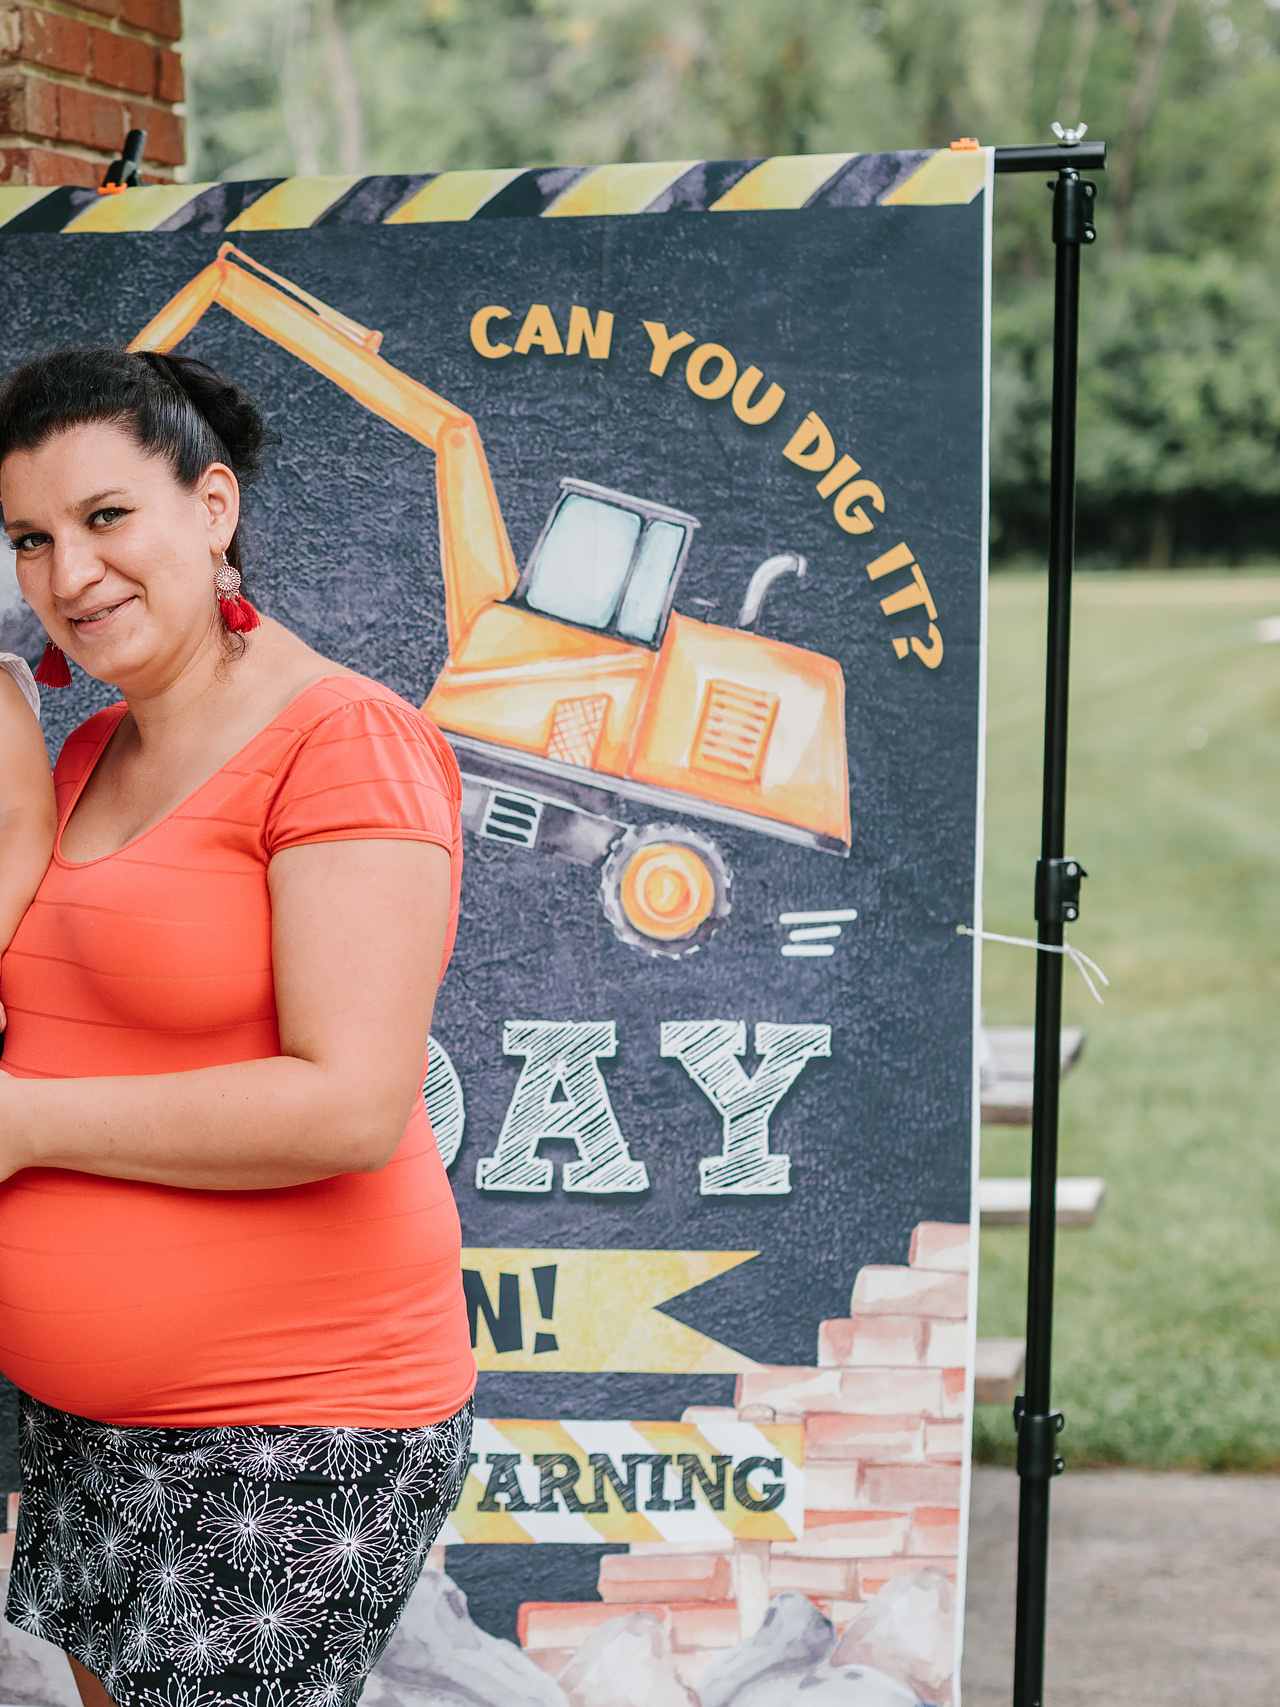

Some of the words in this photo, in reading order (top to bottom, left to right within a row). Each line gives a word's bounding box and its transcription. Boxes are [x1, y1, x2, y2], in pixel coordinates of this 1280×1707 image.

[469, 303, 615, 360] CAN
[642, 320, 787, 426] YOU
[782, 411, 886, 535] DIG
[866, 541, 945, 671] IT?
